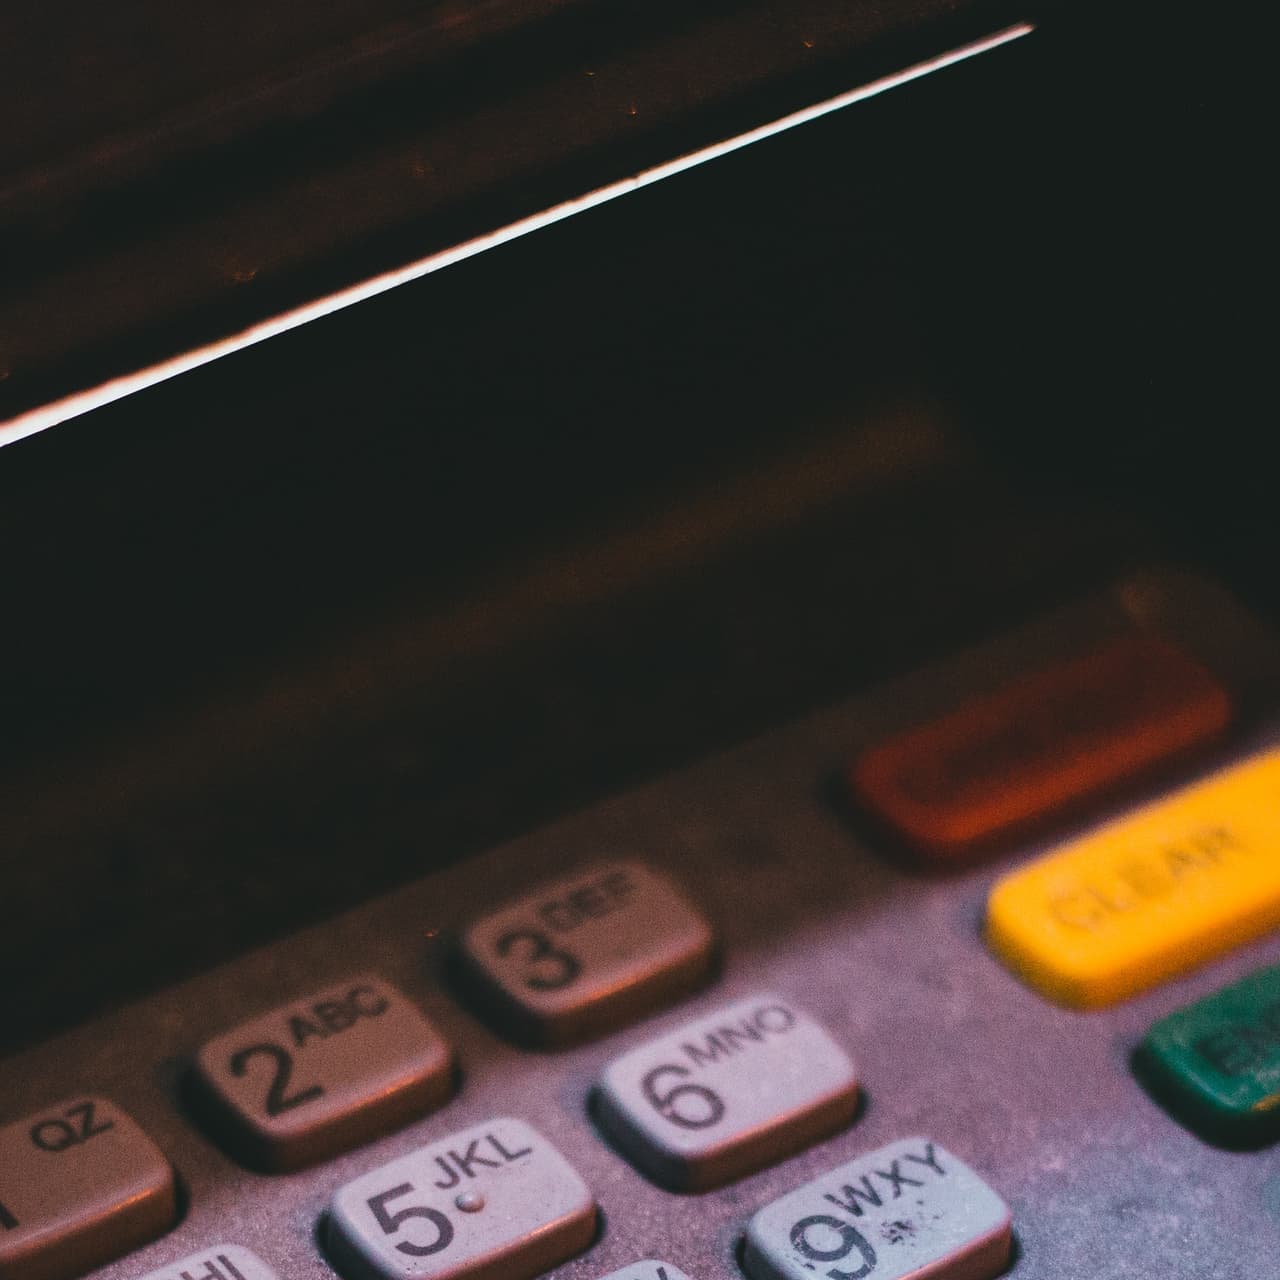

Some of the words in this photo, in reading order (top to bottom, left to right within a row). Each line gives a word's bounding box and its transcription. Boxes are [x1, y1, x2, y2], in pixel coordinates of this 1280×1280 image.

[496, 926, 582, 990] 3
[230, 1044, 323, 1117] 2
[289, 985, 389, 1046] ABC
[682, 1005, 796, 1069] MNO
[30, 1103, 113, 1151] QZ
[641, 1064, 726, 1131] 6
[366, 1182, 455, 1256] 5
[434, 1135, 534, 1191] JKL
[824, 1143, 948, 1217] WXY
